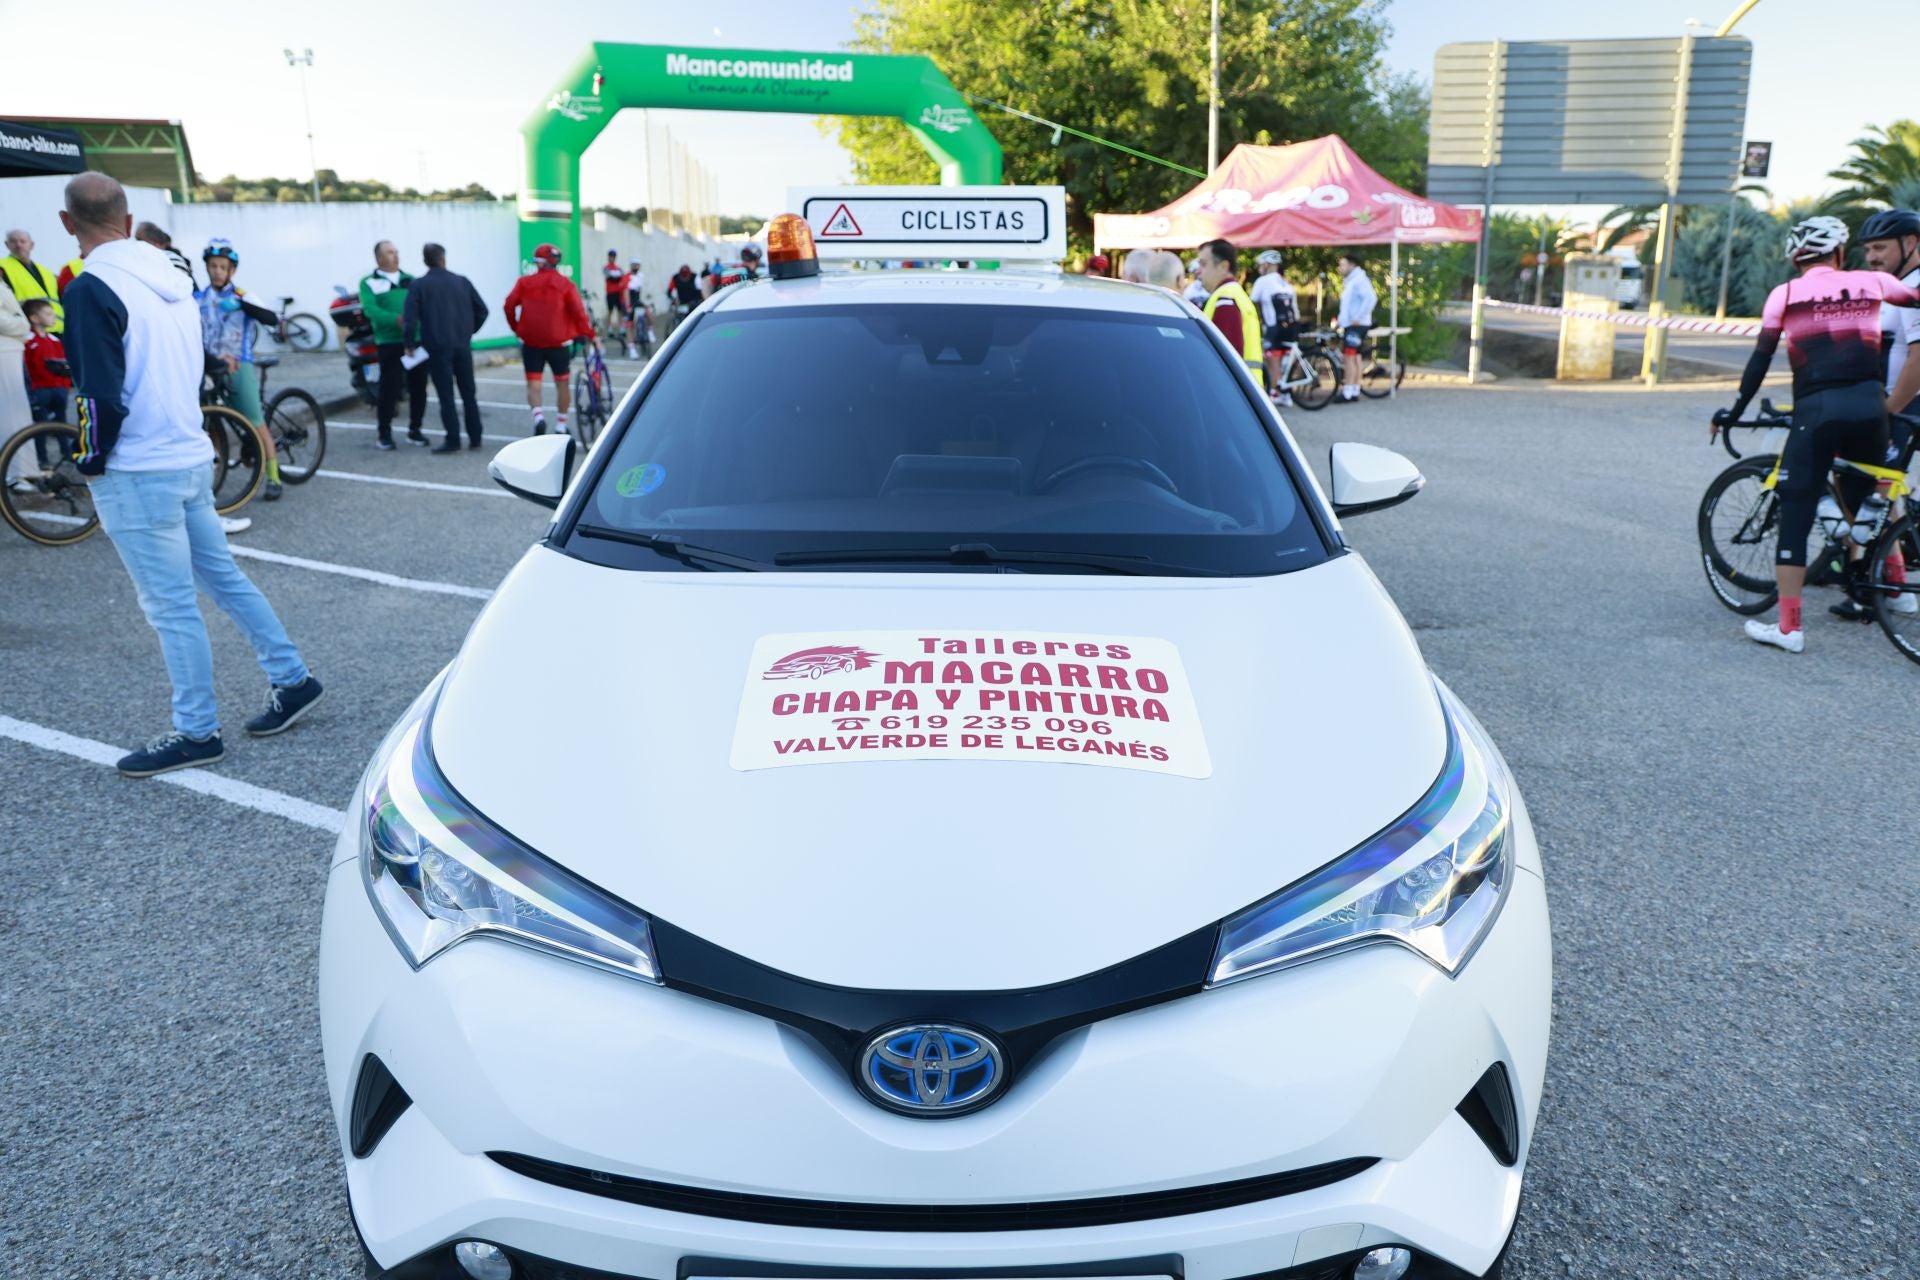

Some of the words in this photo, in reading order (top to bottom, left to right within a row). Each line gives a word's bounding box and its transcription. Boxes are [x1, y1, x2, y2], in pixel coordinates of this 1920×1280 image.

[666, 53, 854, 82] Mancomunidad
[752, 80, 767, 95] de
[0, 130, 80, 157] bano-bike.com
[902, 210, 1024, 230] CICLISTAS
[1813, 310, 1870, 322] Badajoz
[1843, 300, 1870, 311] Club
[918, 638, 1132, 661] Talleres
[883, 660, 1170, 694] MACARRO
[772, 689, 918, 716] CHAPA
[936, 689, 961, 710] Y
[979, 689, 1170, 722] PINTURA
[880, 715, 949, 730] 619
[963, 715, 1032, 731] 235
[1045, 717, 1113, 735] 096
[773, 734, 949, 755] VALVERDE
[961, 734, 1005, 749] DE
[1016, 735, 1170, 762] LEGANÉS
